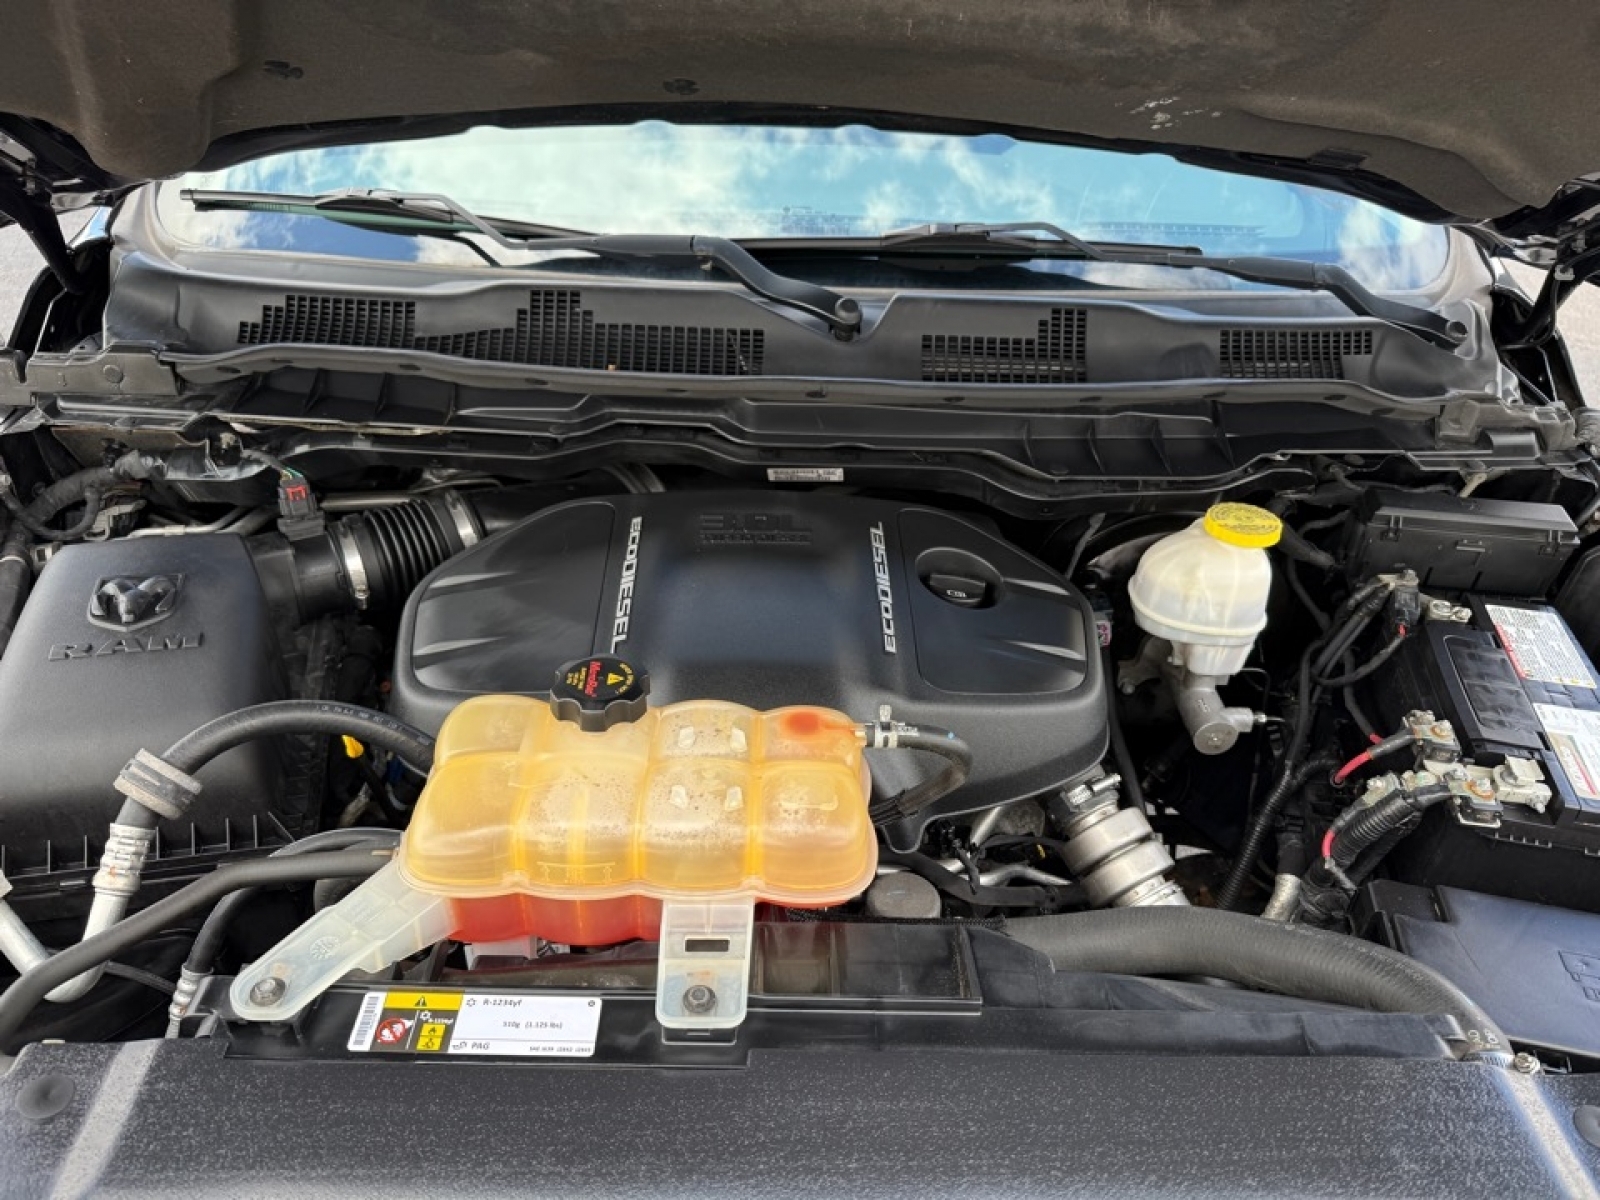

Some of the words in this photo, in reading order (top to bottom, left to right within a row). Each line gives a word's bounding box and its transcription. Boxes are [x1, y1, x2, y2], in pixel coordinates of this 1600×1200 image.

[610, 516, 643, 654] ECODIESEL
[869, 521, 897, 653] ECODIESEL
[48, 633, 205, 661] RAM
[482, 998, 522, 1008] R-1234yf
[471, 1042, 491, 1051] PAG
